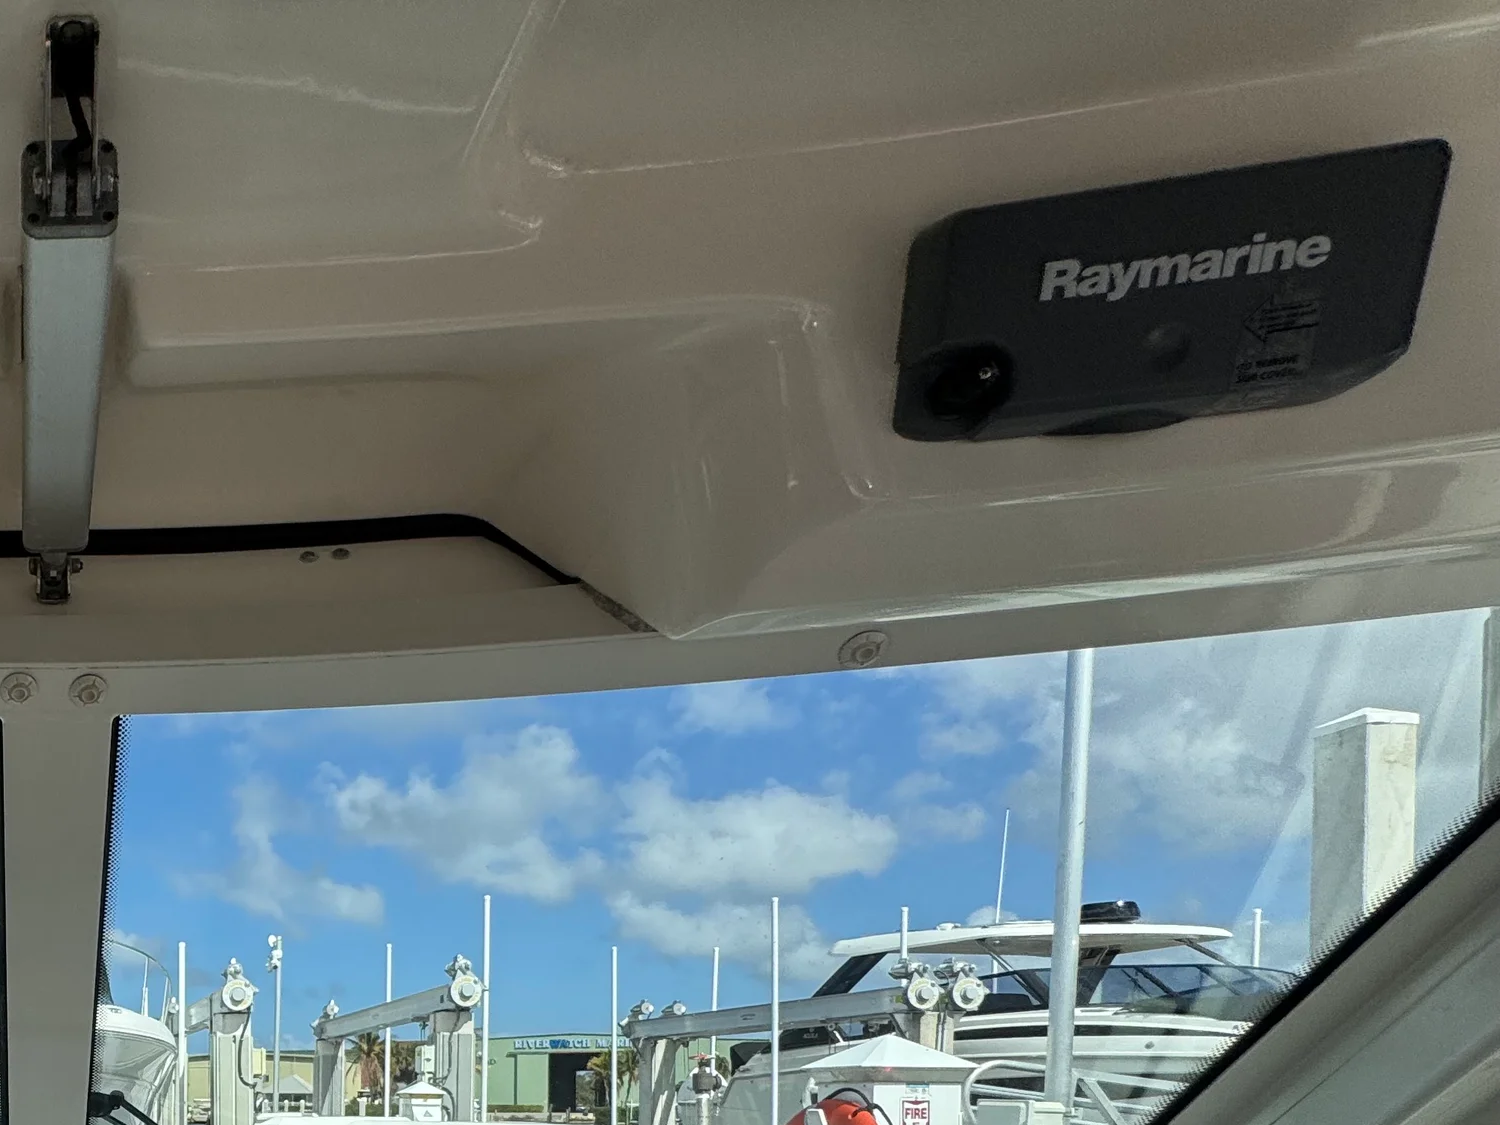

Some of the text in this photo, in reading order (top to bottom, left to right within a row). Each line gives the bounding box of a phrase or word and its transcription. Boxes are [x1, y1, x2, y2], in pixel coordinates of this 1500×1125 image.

[1039, 231, 1332, 301] Raymarine
[595, 1038, 632, 1049] MARI
[905, 1107, 927, 1119] FIRE
